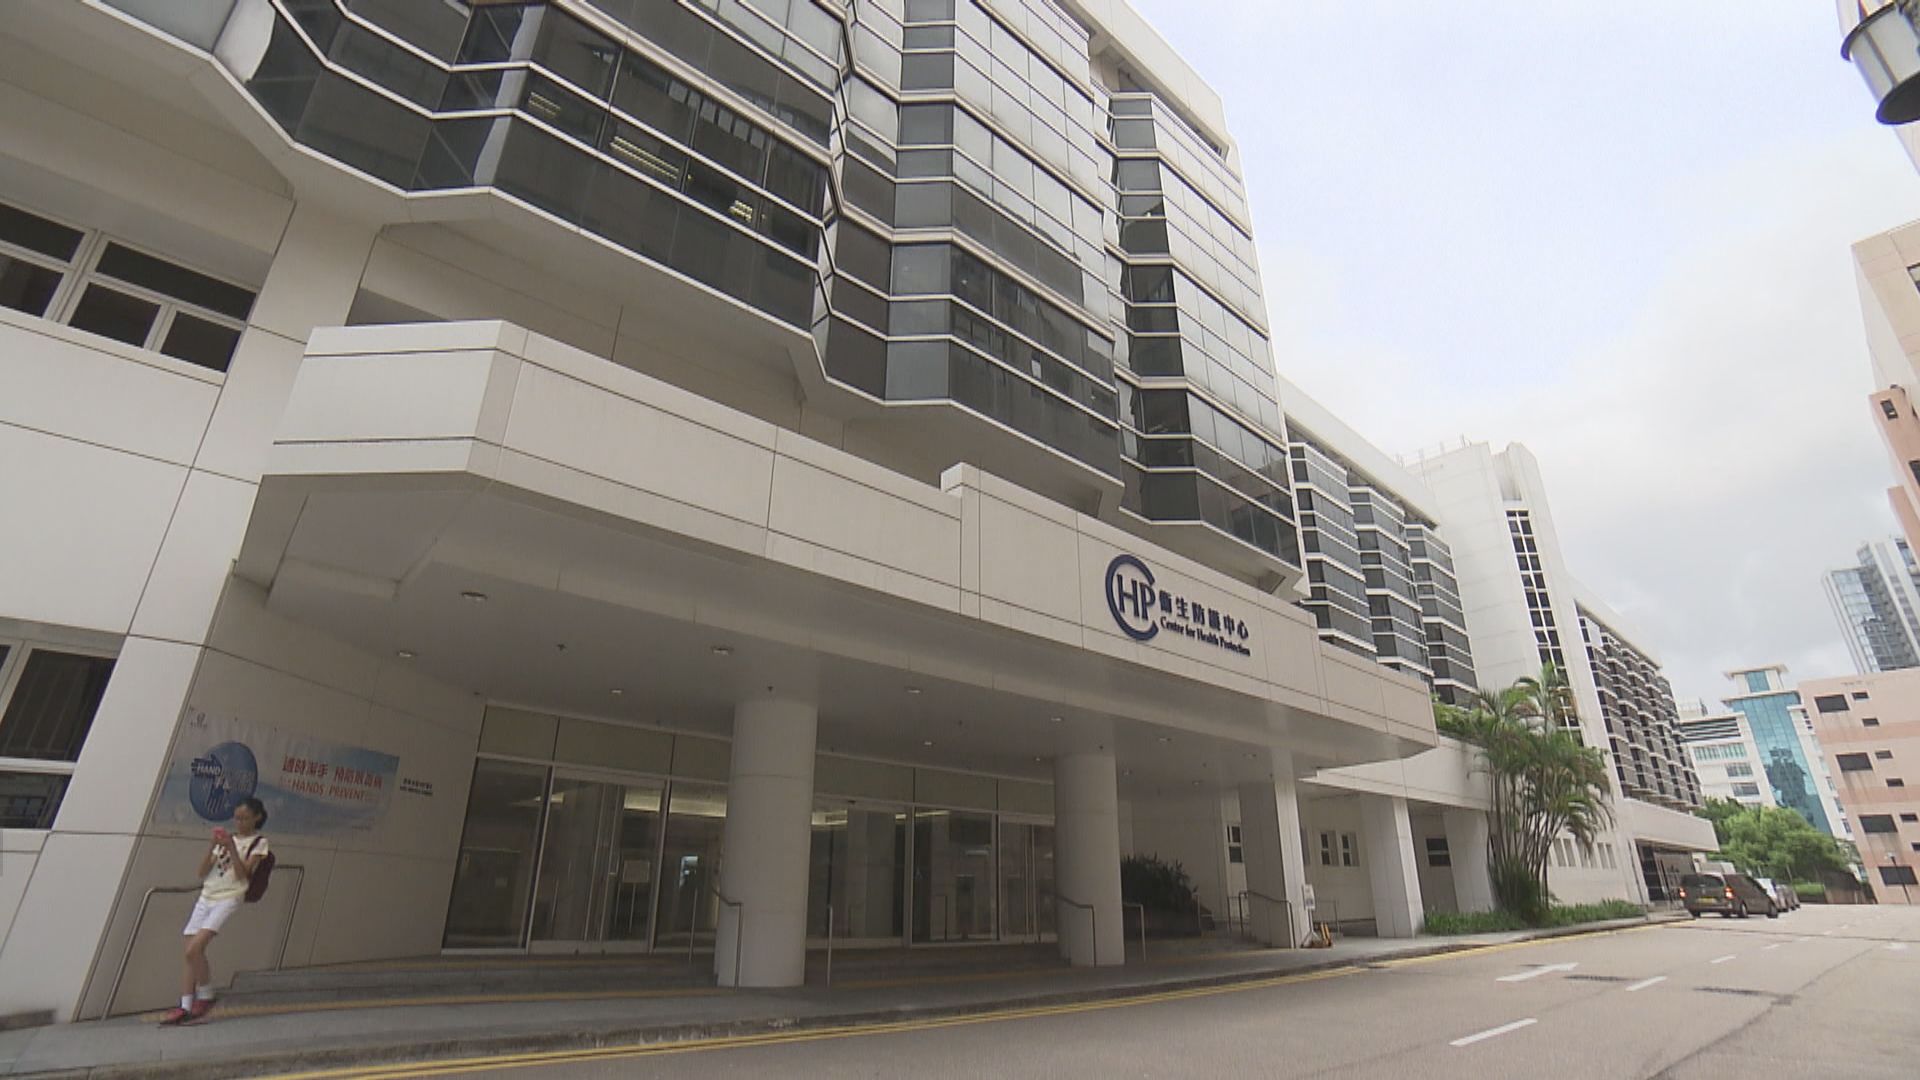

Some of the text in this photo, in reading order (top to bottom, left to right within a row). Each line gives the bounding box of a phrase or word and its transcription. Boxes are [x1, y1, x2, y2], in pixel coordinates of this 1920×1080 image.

[1105, 554, 1158, 641] CHP
[1160, 616, 1250, 656] Centre for Health Protection
[292, 779, 324, 795] HANDS
